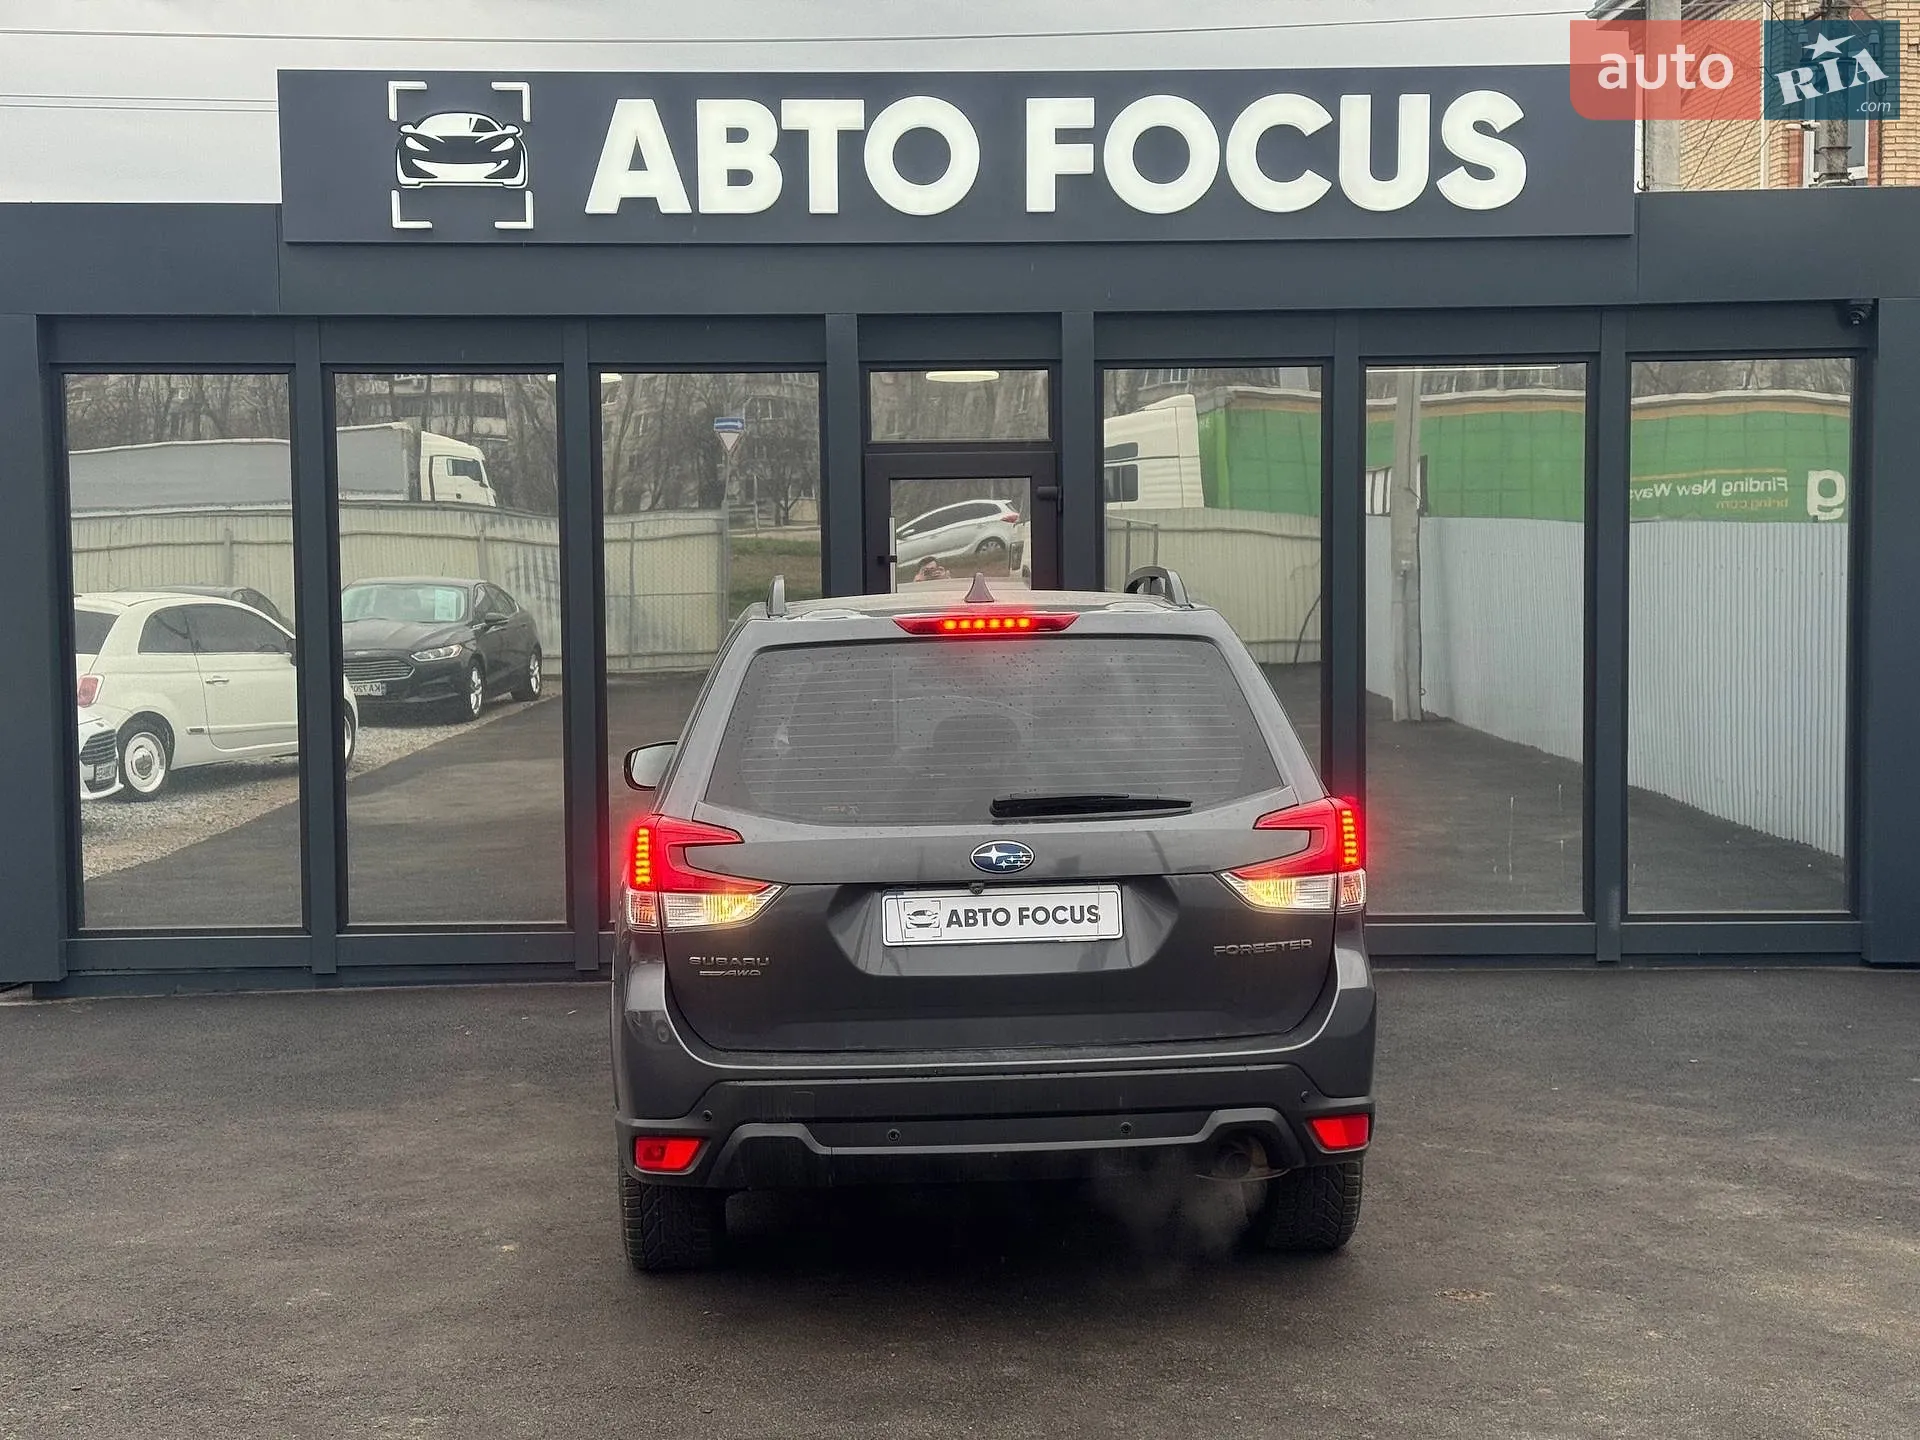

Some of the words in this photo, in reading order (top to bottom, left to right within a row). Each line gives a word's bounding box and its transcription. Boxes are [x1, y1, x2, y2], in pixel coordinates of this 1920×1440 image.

[584, 95, 981, 216] АВТО
[1026, 89, 1527, 214] FOCUS
[946, 907, 1011, 928] АВТО
[1018, 904, 1100, 926] FOCUS
[1213, 938, 1313, 957] FORESTER
[689, 956, 770, 966] SUBARU
